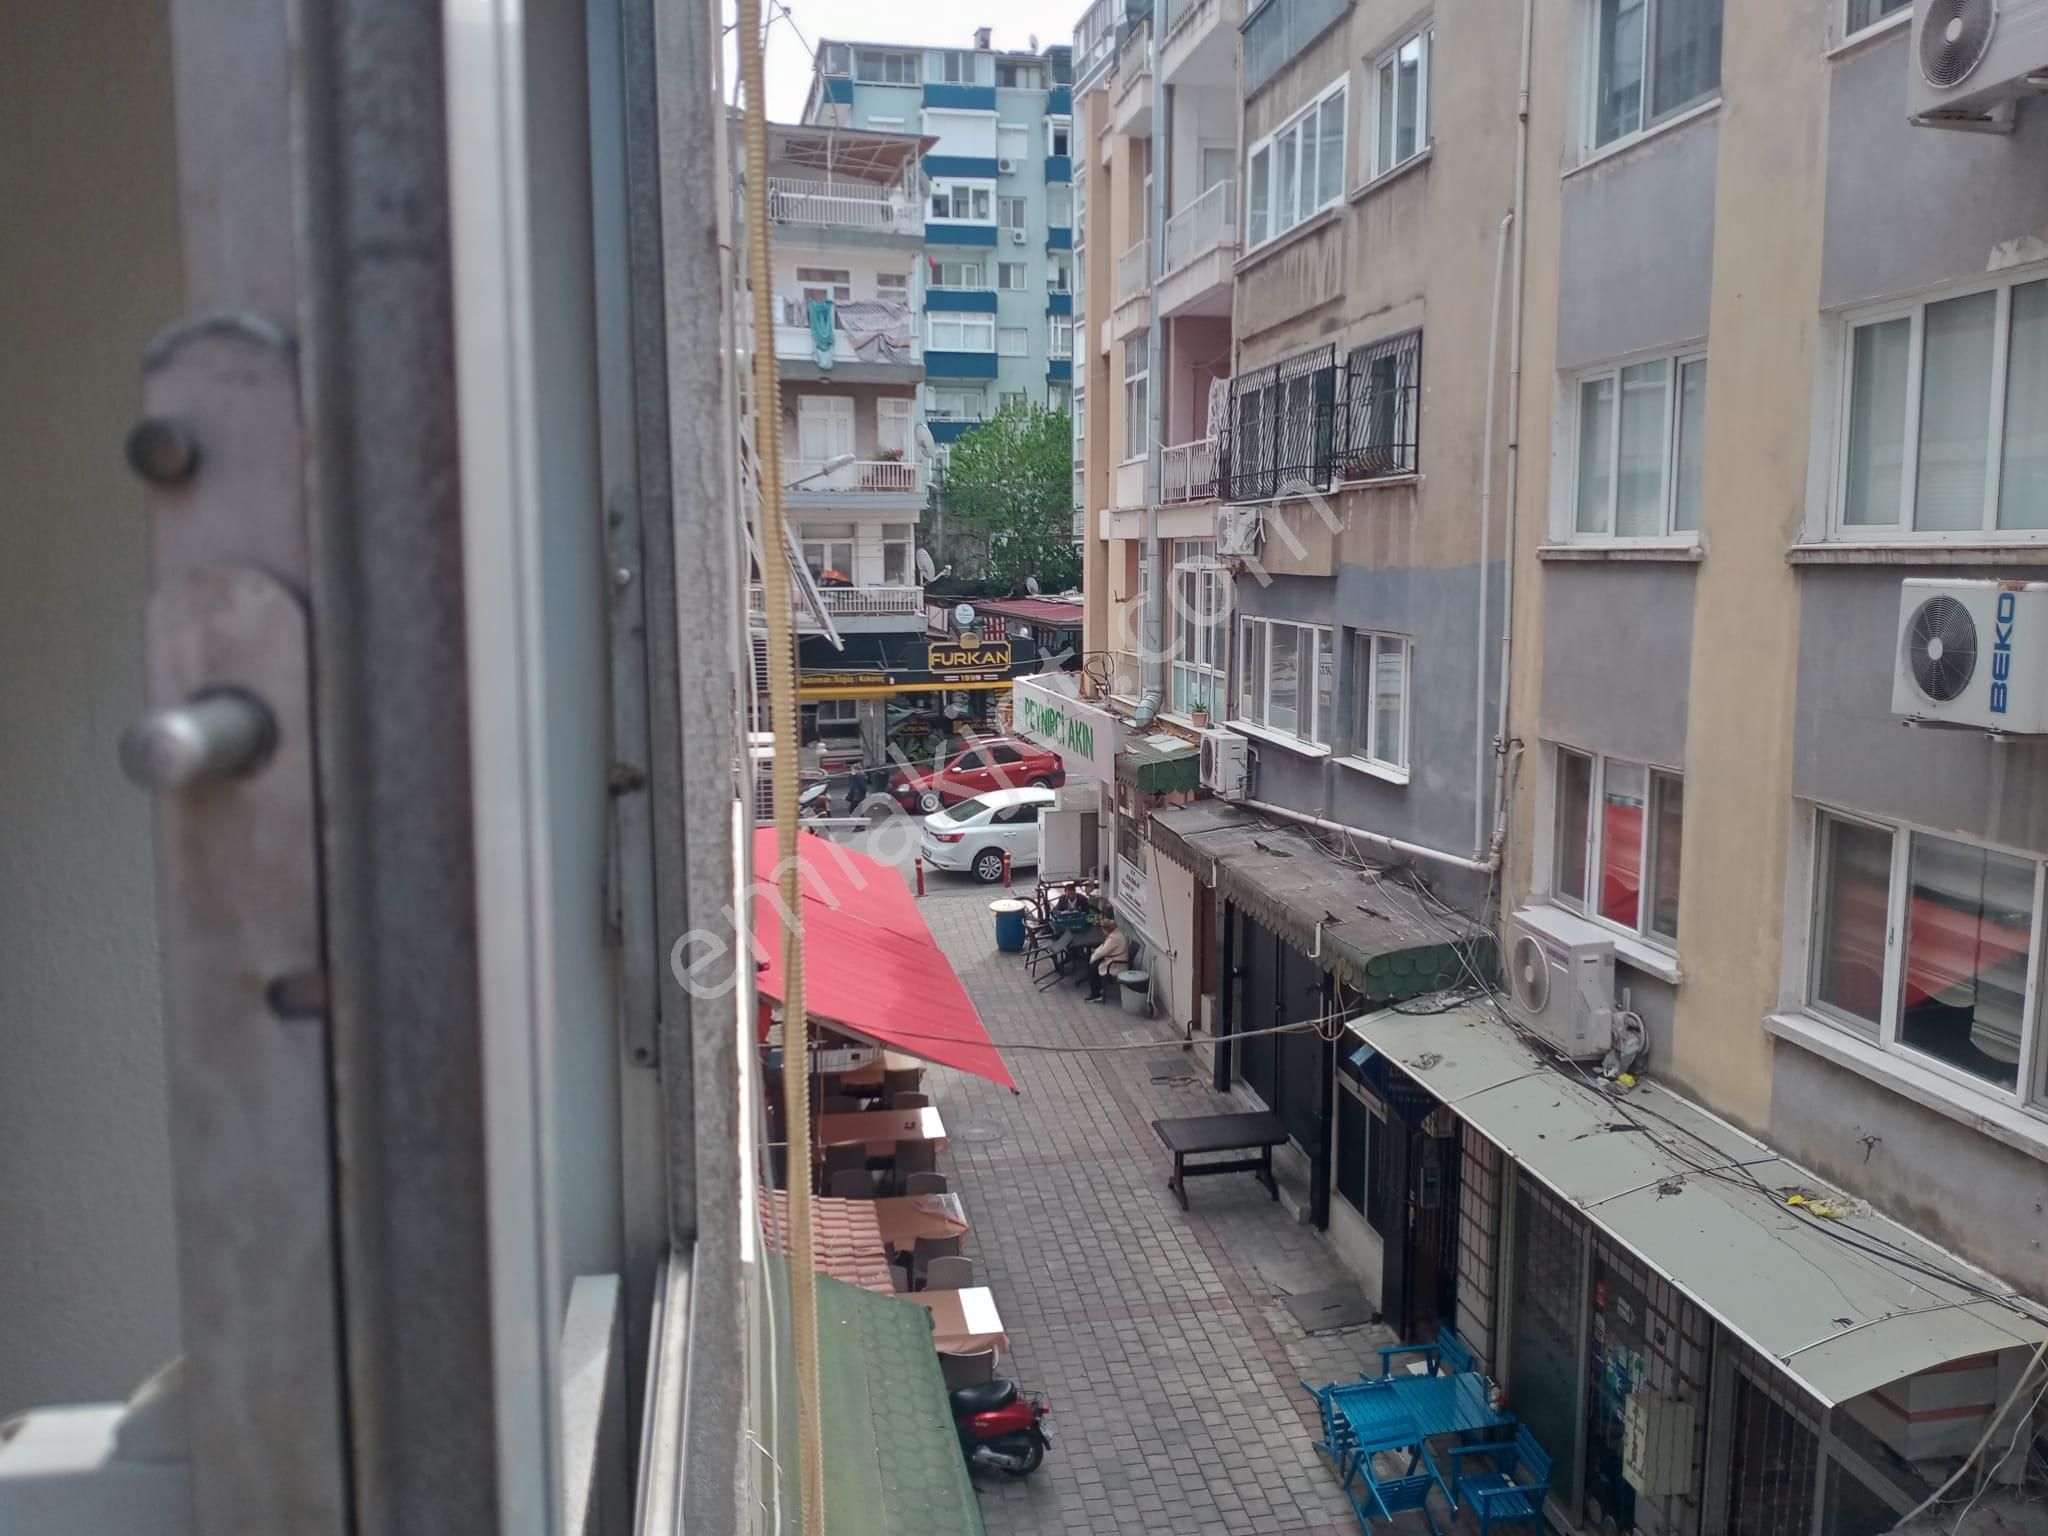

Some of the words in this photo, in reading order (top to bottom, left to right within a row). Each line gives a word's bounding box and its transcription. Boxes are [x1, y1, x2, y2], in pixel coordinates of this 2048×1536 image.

[931, 650, 1009, 666] FURKAN
[1990, 592, 2015, 713] BEKO
[1068, 718, 1094, 762] AKIN
